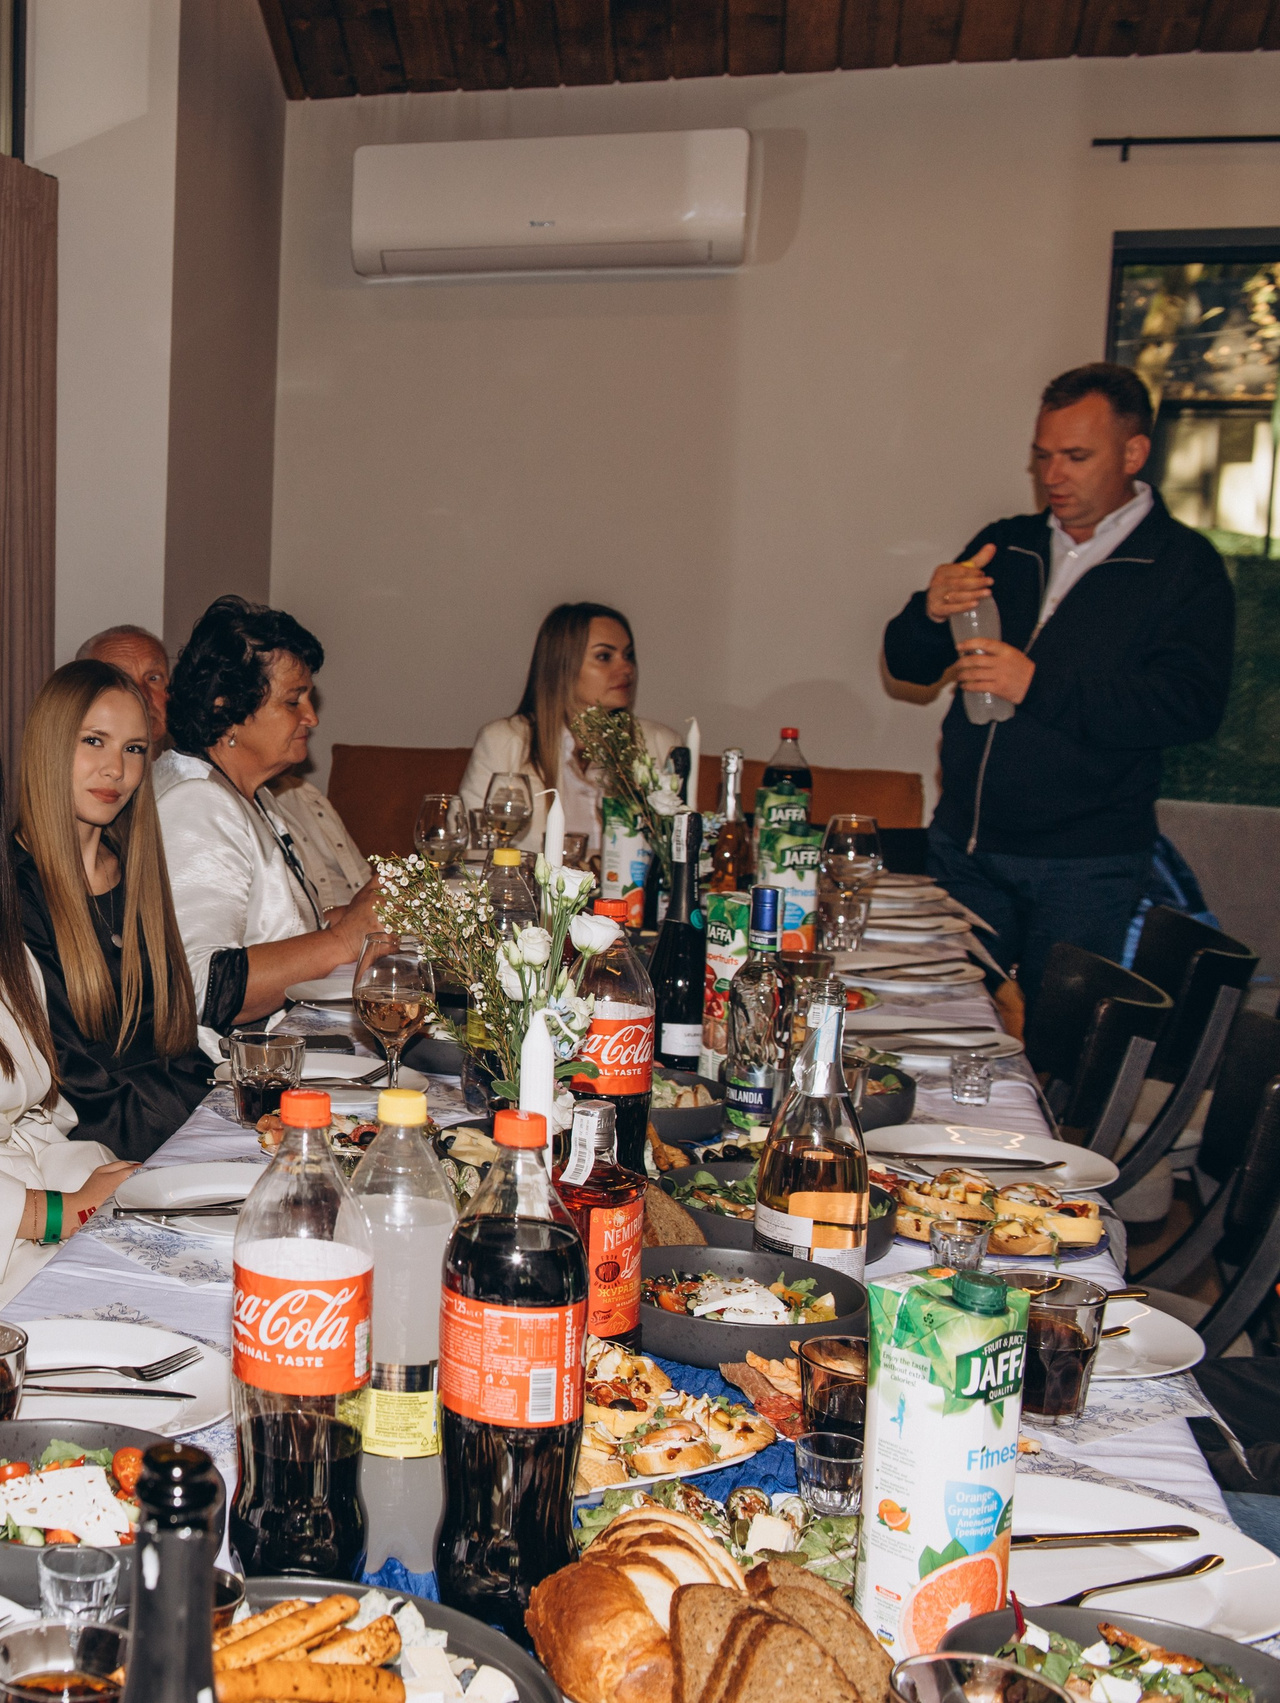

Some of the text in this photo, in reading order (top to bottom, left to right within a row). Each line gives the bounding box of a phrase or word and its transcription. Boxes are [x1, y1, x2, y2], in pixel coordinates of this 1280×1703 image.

[613, 1067, 643, 1076] TASTE
[726, 1086, 764, 1105] FINLANDIA
[233, 1285, 358, 1351] ca-Cola
[983, 1334, 1024, 1356] FRUIT & JUICE
[275, 1353, 324, 1368] TASTE
[882, 1350, 928, 1373] Enjoy the taste
[883, 1361, 926, 1381] without extra
[988, 1383, 1014, 1400] QUALITY
[956, 1490, 995, 1504] Orange-
[948, 1499, 998, 1518] Grapefruit
